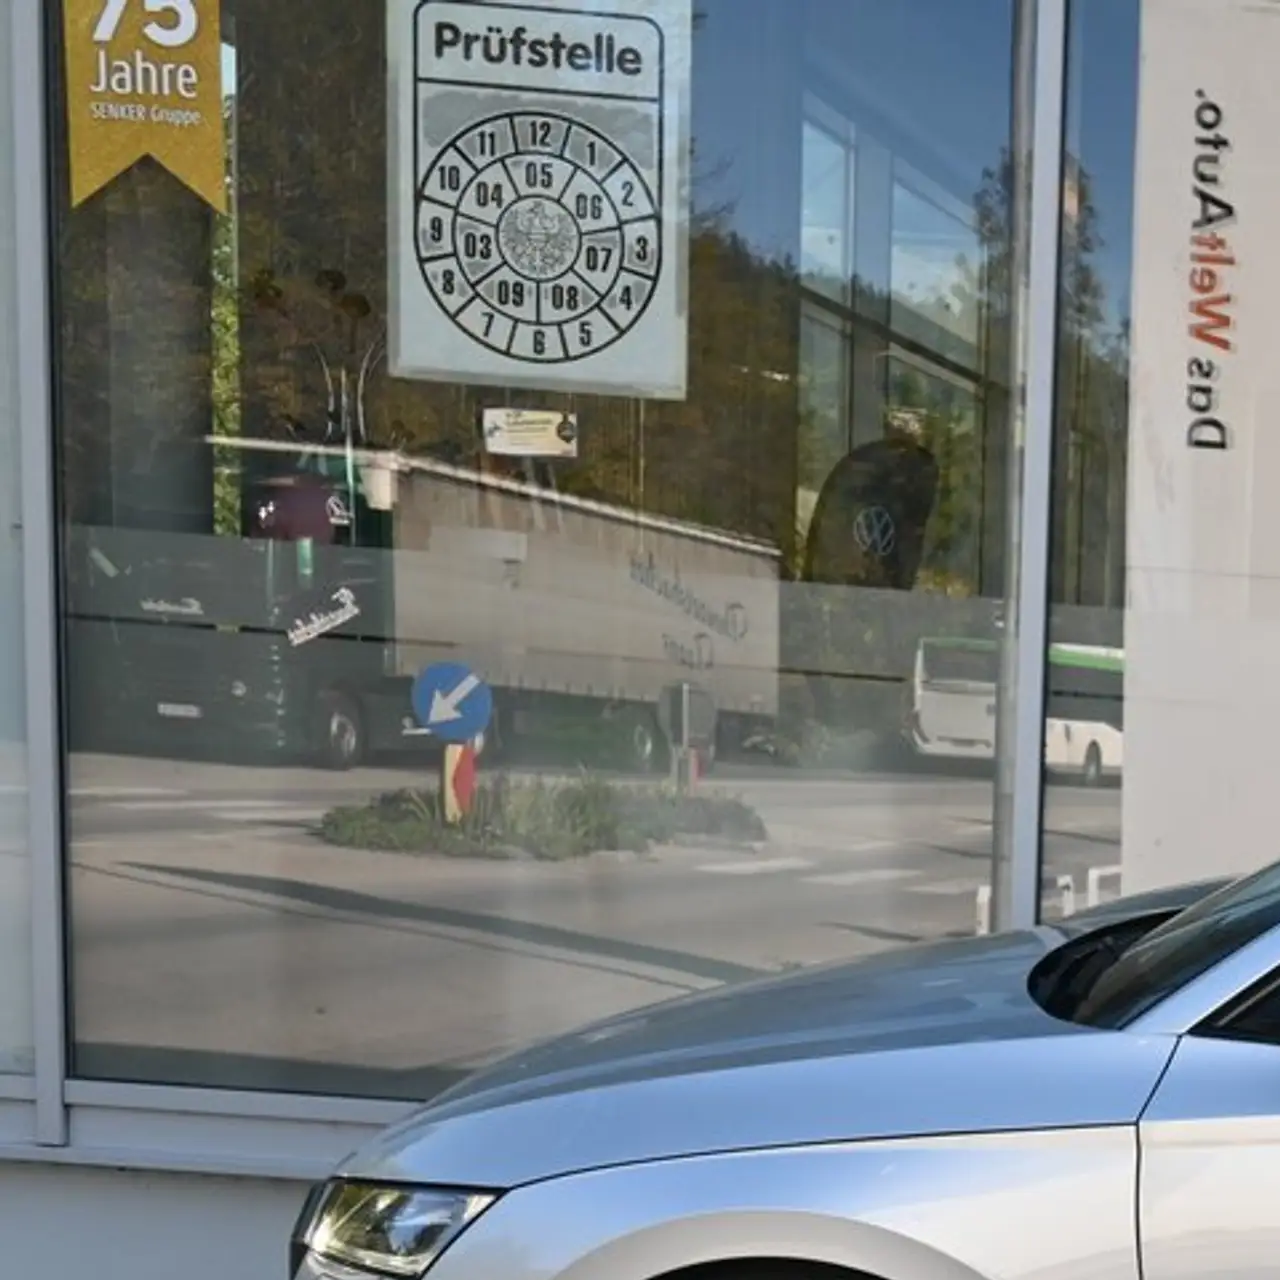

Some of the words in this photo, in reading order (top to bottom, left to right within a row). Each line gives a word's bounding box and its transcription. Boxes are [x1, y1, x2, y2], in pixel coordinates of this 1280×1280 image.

[434, 21, 643, 76] Prüfstelle
[89, 48, 198, 98] Jahre
[150, 104, 201, 126] Gruppe
[478, 132, 496, 155] 11
[530, 121, 551, 146] 12
[586, 141, 597, 166] 1
[438, 166, 460, 191] 10
[525, 162, 553, 188] 05
[475, 182, 503, 207] 04
[576, 193, 602, 220] 06
[621, 181, 635, 207] 2
[429, 217, 443, 242] 9
[464, 233, 492, 259] 03
[635, 236, 648, 261] 3
[586, 246, 613, 272] 07
[441, 269, 455, 294] 8
[499, 281, 524, 306] 09
[551, 285, 579, 310] 08
[618, 285, 632, 310] 4
[481, 312, 495, 337] 7
[578, 321, 592, 346] 5
[533, 330, 546, 355] 6
